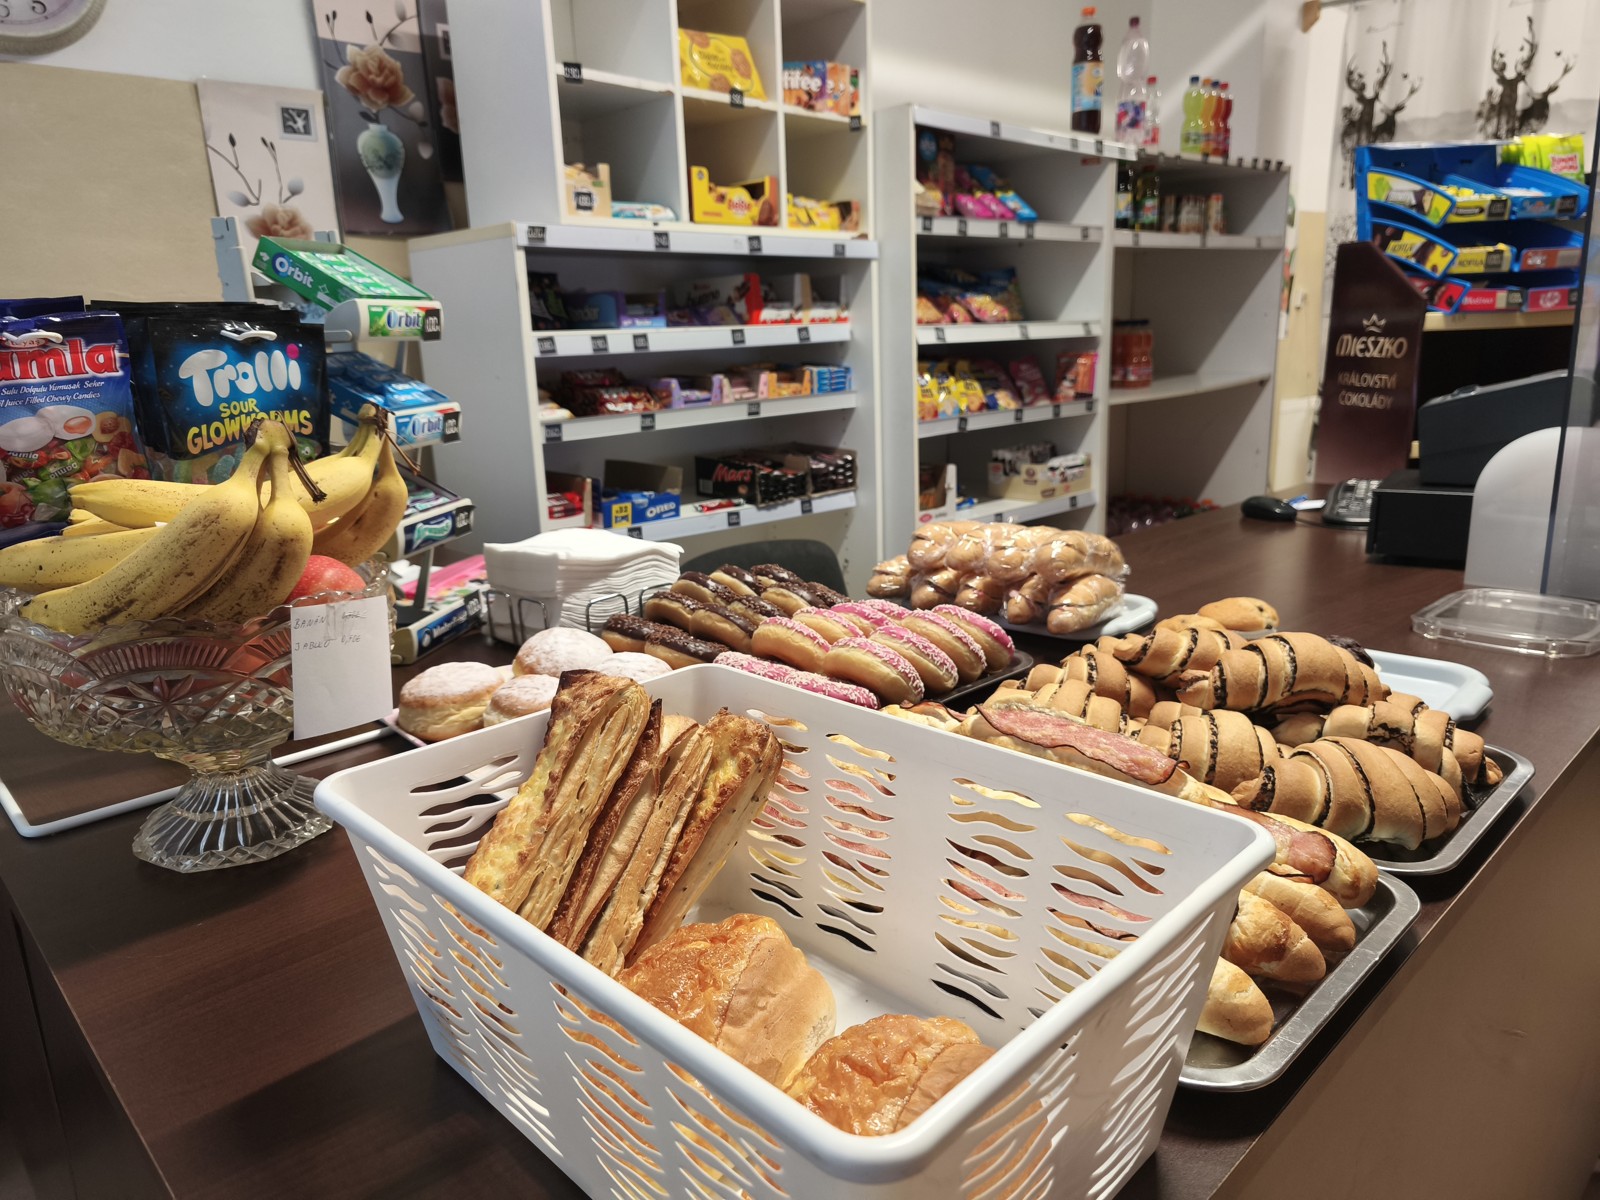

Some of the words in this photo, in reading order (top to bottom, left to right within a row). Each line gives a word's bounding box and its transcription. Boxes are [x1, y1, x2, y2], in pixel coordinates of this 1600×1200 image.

[275, 256, 314, 288] Orbit
[387, 309, 422, 328] Orbit
[1335, 334, 1409, 359] MIESZKO
[180, 343, 302, 407] Trolli
[46, 393, 72, 403] Chewy
[73, 390, 101, 400] Candies
[219, 398, 259, 418] SOUR
[412, 416, 443, 436] Orbit
[712, 463, 752, 482] Mars
[645, 502, 676, 518] OREO
